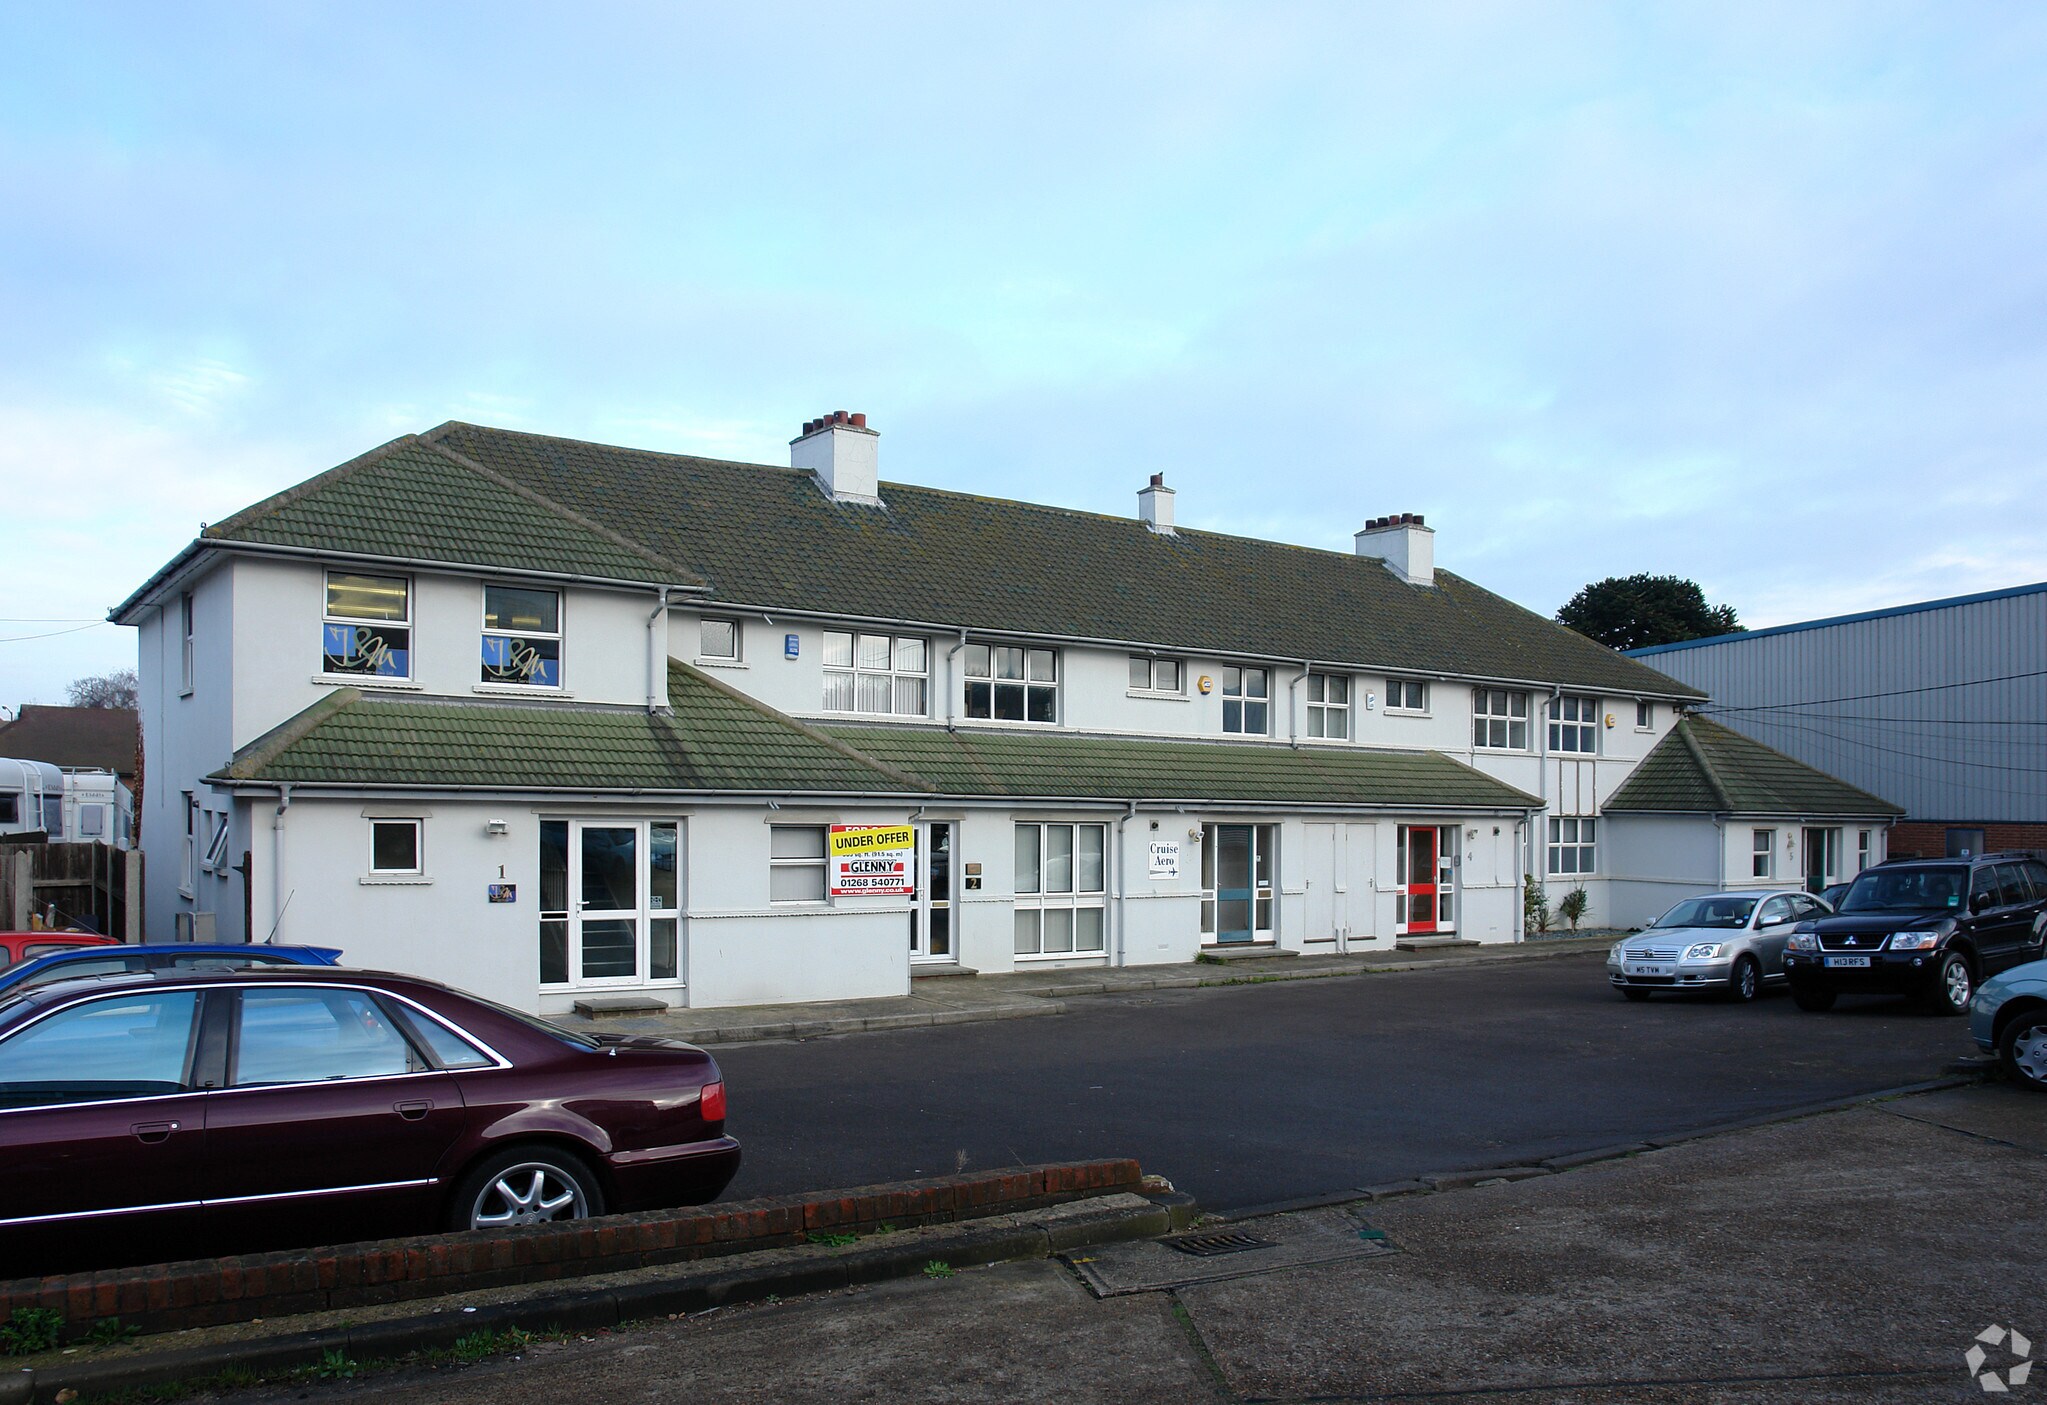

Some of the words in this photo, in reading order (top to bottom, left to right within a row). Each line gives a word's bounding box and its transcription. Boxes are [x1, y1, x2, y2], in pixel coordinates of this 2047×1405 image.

[836, 835, 874, 849] UNDER
[876, 831, 910, 845] OFFER
[1150, 843, 1179, 854] Cruise
[1154, 855, 1175, 866] Aero
[498, 864, 506, 879] 1
[850, 861, 895, 873] GLENNY
[840, 879, 868, 887] 01268
[871, 878, 905, 887] 540771
[970, 878, 977, 889] 2
